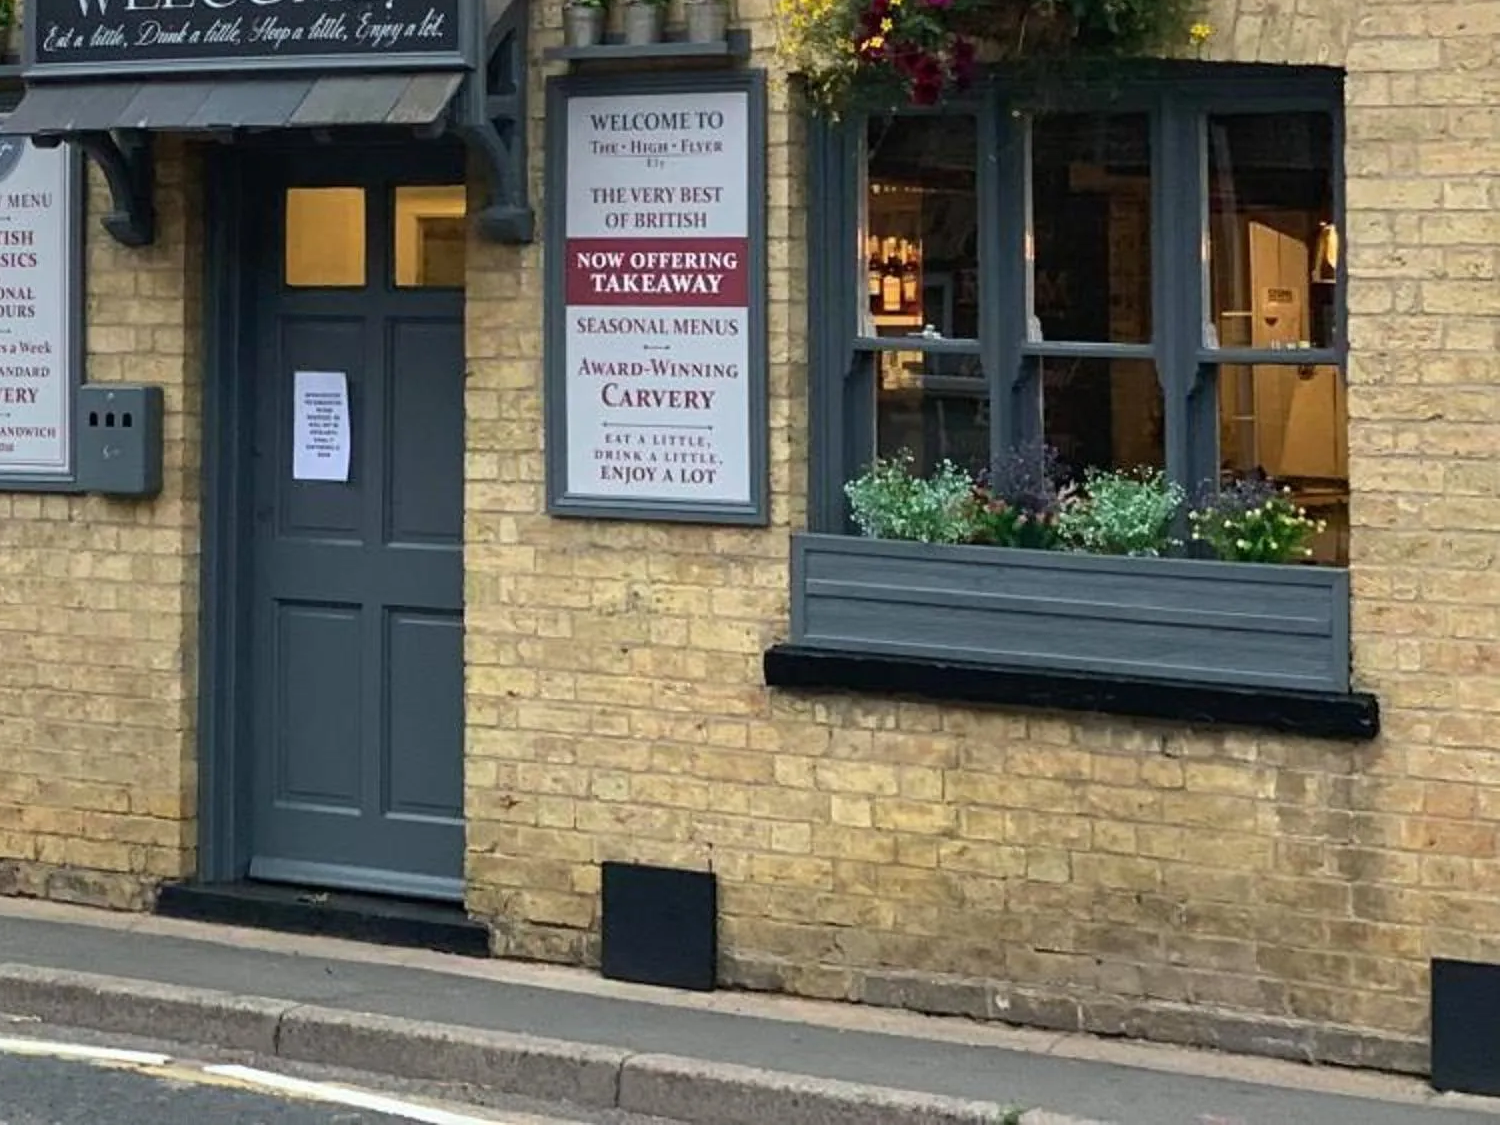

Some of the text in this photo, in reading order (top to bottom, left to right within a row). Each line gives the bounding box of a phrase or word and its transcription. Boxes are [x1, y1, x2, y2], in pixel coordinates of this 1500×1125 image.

[43, 25, 74, 52] Eat
[73, 35, 84, 48] a
[89, 24, 128, 48] little,
[188, 29, 200, 44] a
[203, 16, 243, 45] little,
[291, 26, 303, 40] a
[307, 13, 349, 41] little,
[355, 12, 404, 48] Enjoy
[404, 23, 416, 37] a
[590, 111, 724, 131] WELCOME TO
[591, 138, 723, 154] THE HIGH FLYER
[7, 193, 52, 208] MENU
[591, 186, 723, 204] THE VERY BEST
[605, 212, 707, 228] OF BRITISH
[576, 252, 738, 269] NOW OFFERING
[590, 274, 724, 294] TAKEAWAY
[576, 317, 739, 336] SEASONAL MENUS
[9, 344, 17, 353] a
[19, 340, 52, 354] Week
[578, 357, 739, 379] AWARD-WINNING
[601, 383, 716, 409] CARVERY
[605, 434, 630, 444] EAT
[639, 435, 646, 445] A
[594, 450, 642, 462] DRINK
[650, 452, 657, 462] A
[601, 465, 717, 484] ENJOY A LOT
